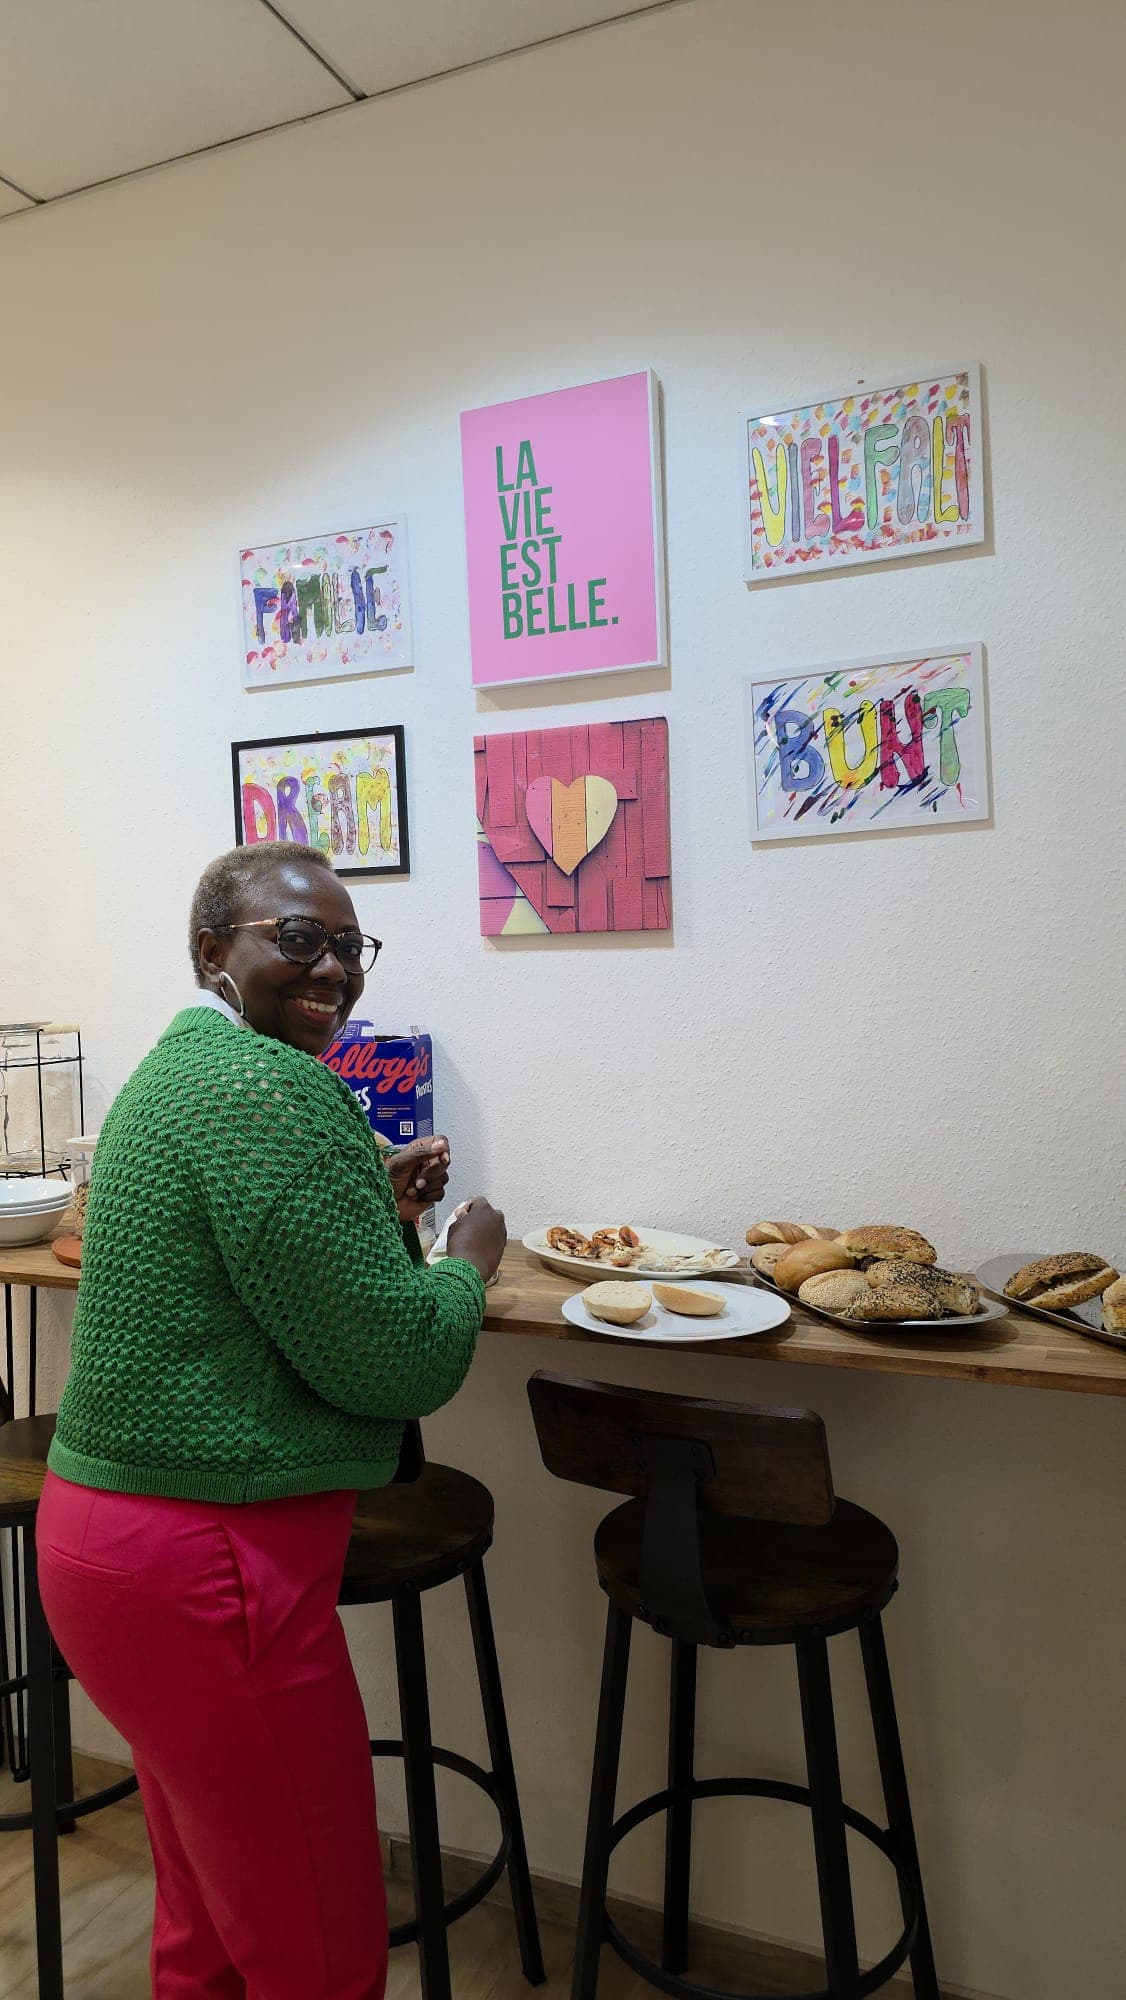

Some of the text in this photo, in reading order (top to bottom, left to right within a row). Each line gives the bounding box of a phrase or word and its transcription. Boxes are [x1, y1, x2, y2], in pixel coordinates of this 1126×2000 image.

[495, 439, 538, 493] LA
[752, 413, 972, 547] VIELFALT
[498, 486, 554, 541] VIE
[500, 535, 562, 592] EST
[253, 564, 389, 645] FAMILIE
[502, 577, 619, 640] BELLE.
[775, 687, 971, 792] BUNT
[242, 768, 392, 856] DREAM
